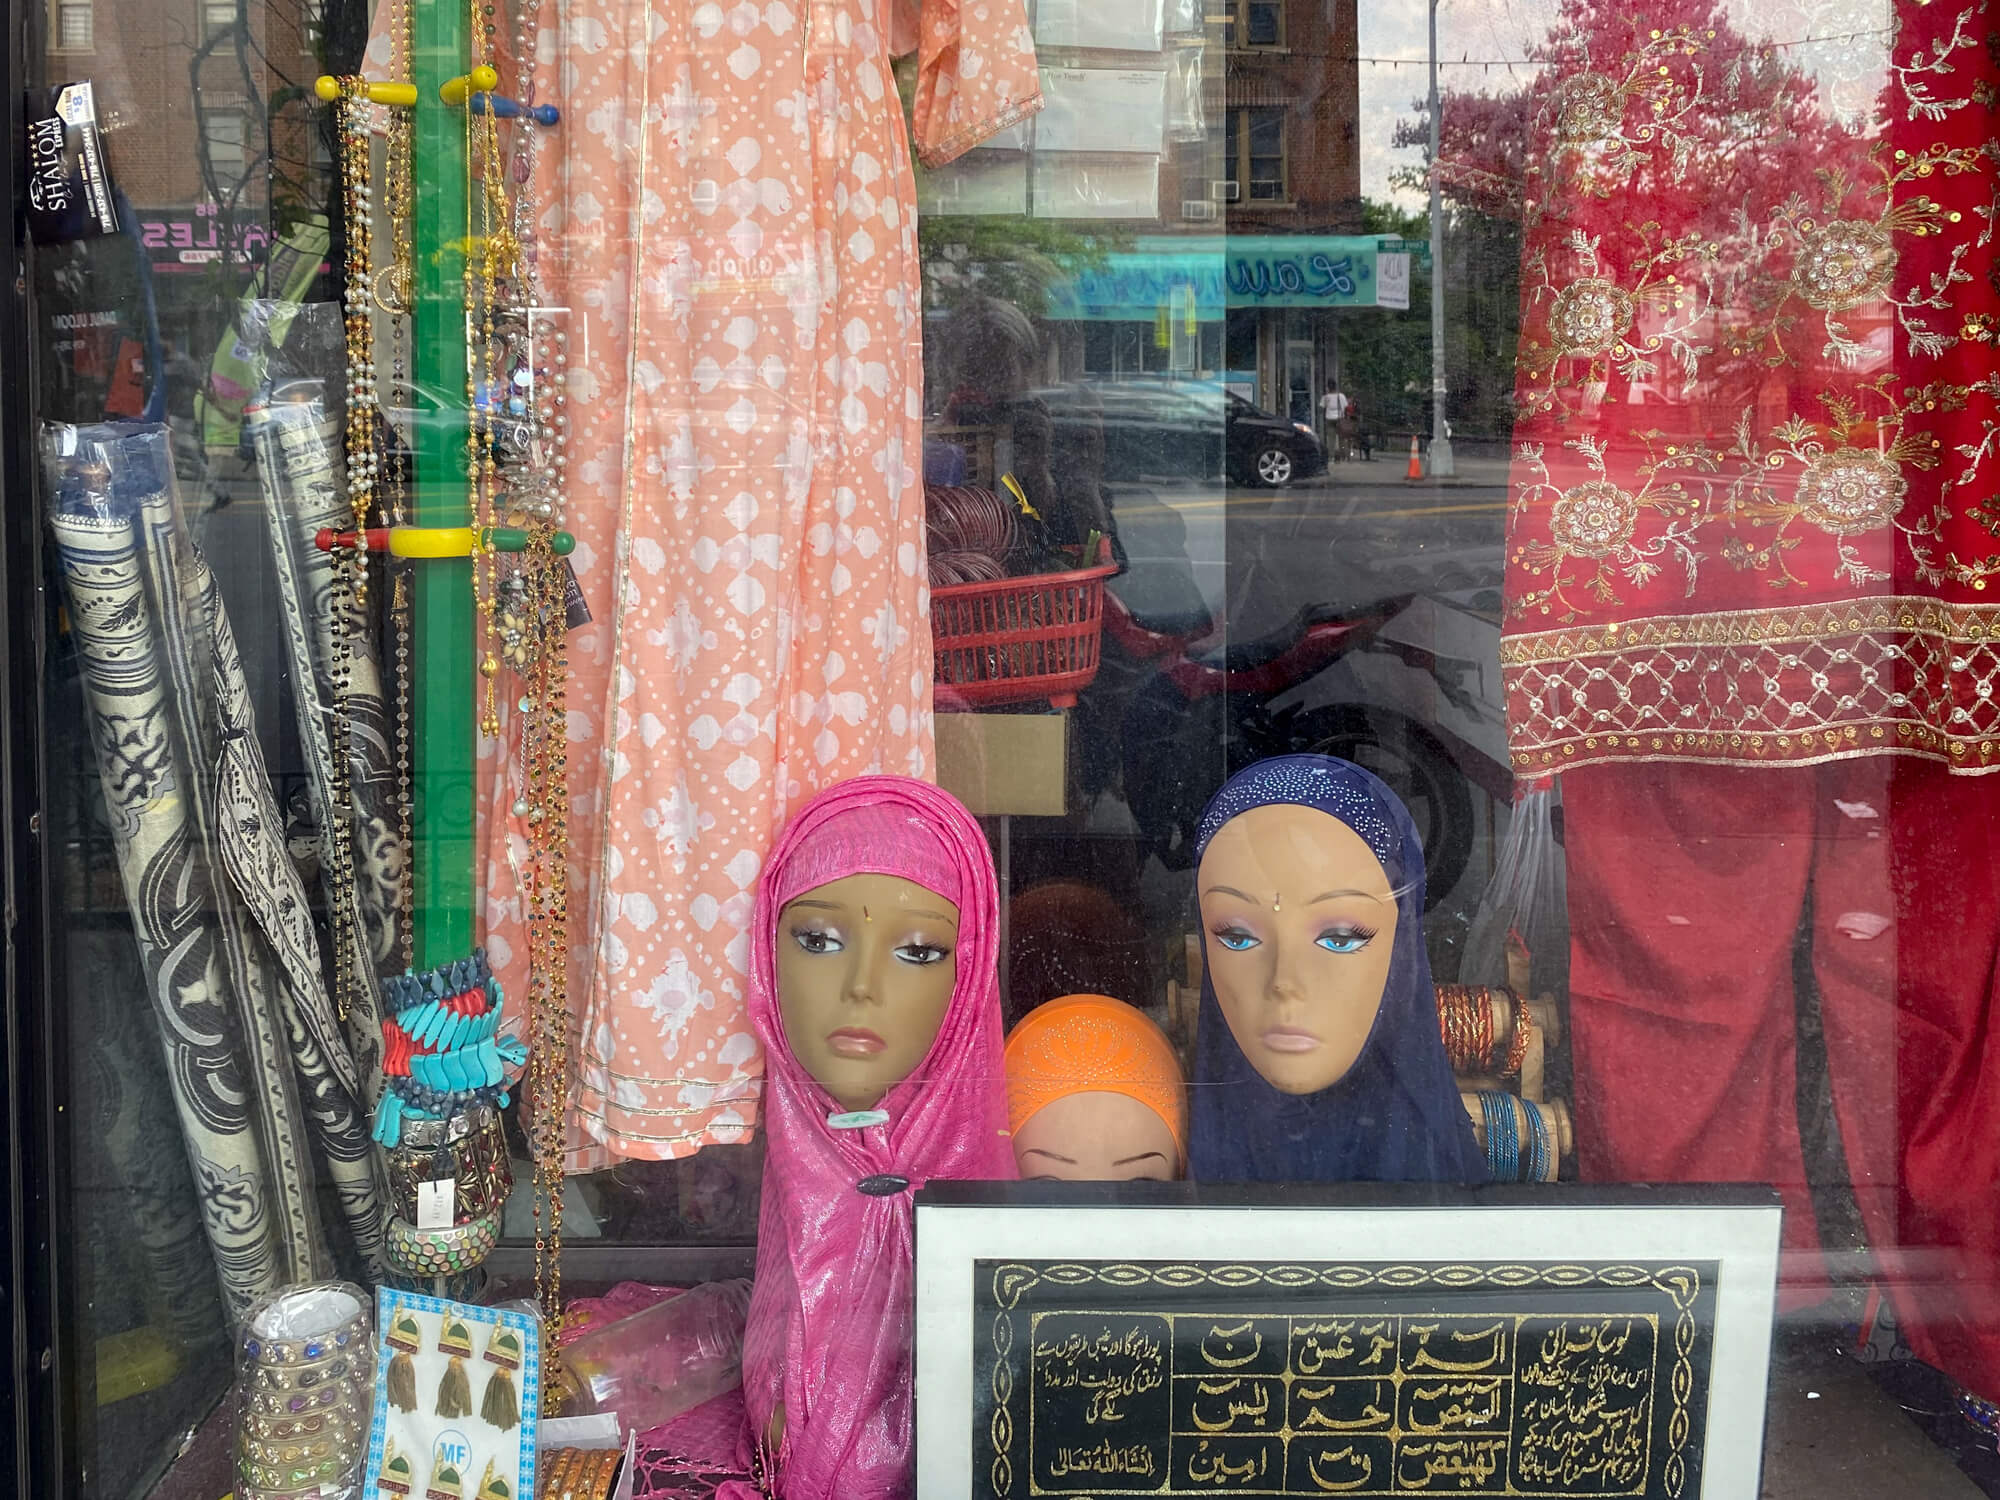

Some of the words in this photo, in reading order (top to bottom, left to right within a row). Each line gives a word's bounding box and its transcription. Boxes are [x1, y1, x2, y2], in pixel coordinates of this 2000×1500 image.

[52, 117, 64, 148] EXPRESS
[35, 118, 67, 210] SHALOM
[1138, 1367, 1162, 1393] رزق
[440, 1441, 466, 1465] MF
